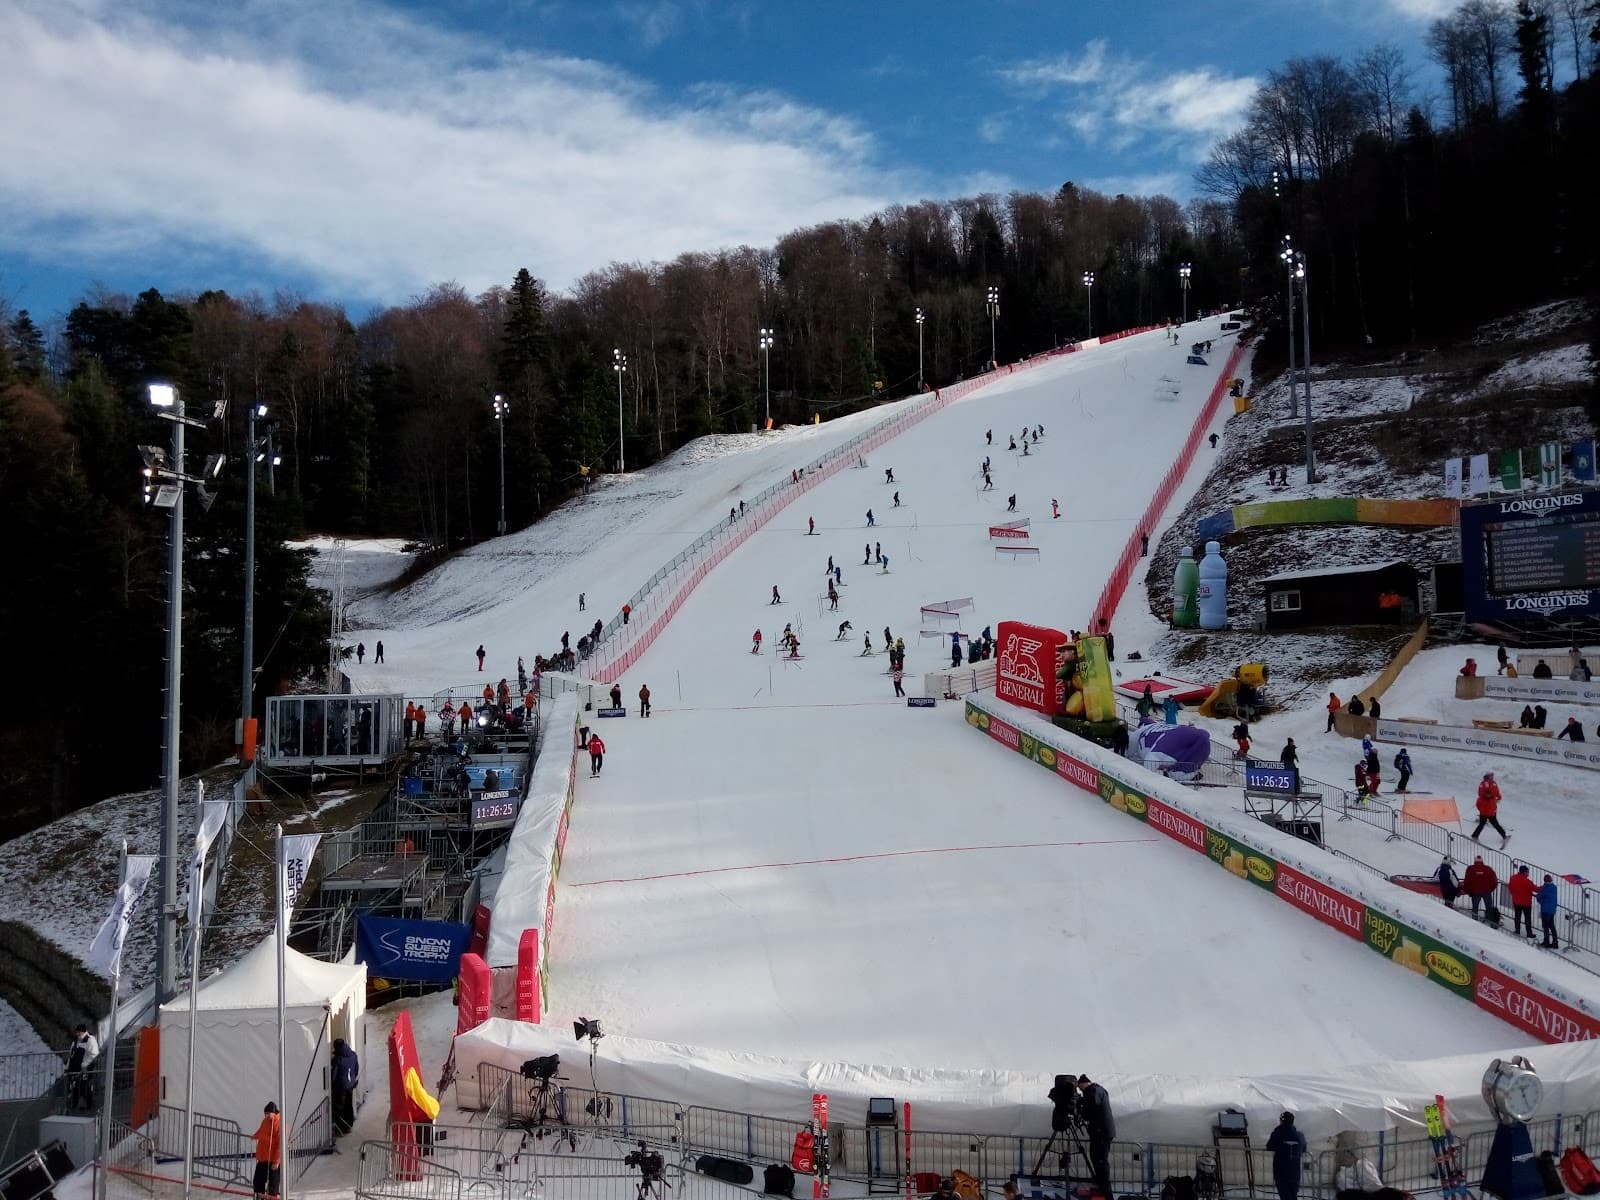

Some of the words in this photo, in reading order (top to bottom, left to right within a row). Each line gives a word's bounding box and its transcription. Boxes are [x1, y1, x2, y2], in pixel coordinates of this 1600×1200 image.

[1501, 493, 1583, 514] LONGINES
[1506, 594, 1589, 610] LONGINES
[999, 679, 1044, 706] GENERALI
[1064, 761, 1098, 789] GENERALI
[1254, 760, 1285, 770] LONGINES
[1251, 775, 1290, 789] 11:26:25
[476, 803, 513, 818] 11:26:25
[1159, 810, 1205, 847] GENERALI
[1251, 859, 1272, 880] RAUCH
[288, 858, 297, 908] QUEEN
[1295, 881, 1361, 932] GENERALI
[1364, 908, 1399, 942] happy
[404, 943, 450, 953] QUEEN
[405, 936, 451, 946] SNOW
[1370, 932, 1393, 953] day
[404, 950, 449, 960] TROPHY
[1436, 954, 1465, 980] RAUCH
